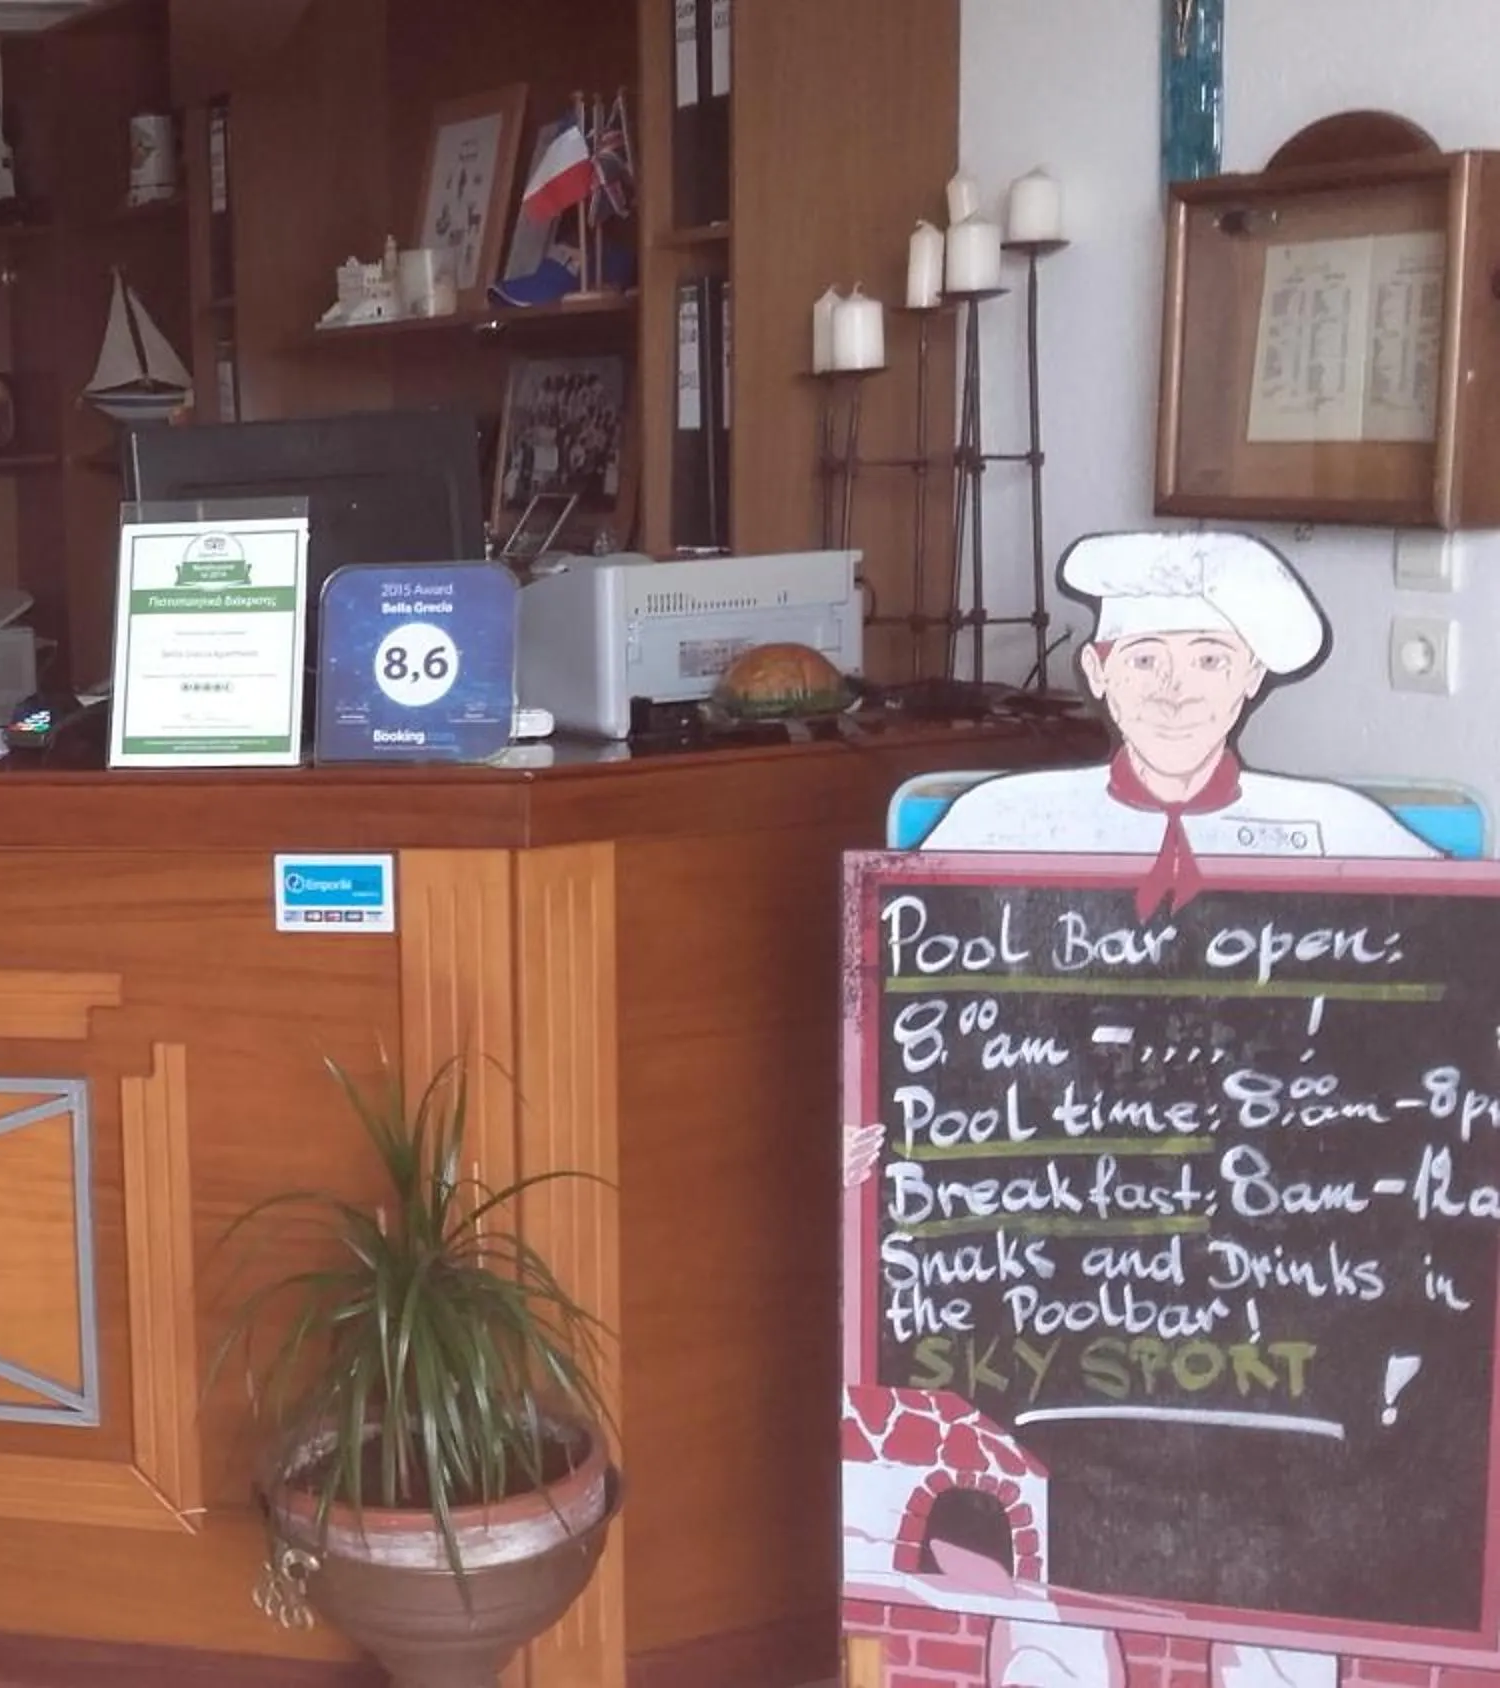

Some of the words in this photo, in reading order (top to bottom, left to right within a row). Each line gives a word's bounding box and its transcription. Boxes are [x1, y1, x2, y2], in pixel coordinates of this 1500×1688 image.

[381, 583, 412, 597] 2015
[414, 582, 454, 595] Award
[381, 602, 412, 615] Bella
[383, 645, 450, 685] 8,6
[882, 895, 1029, 976] Pool
[1052, 911, 1177, 970] Bar
[1206, 921, 1405, 984] open:
[893, 1082, 1037, 1158] Pool
[1053, 1080, 1222, 1137] time:
[885, 1152, 1218, 1223] Breakfast:
[881, 1230, 1056, 1291] Snaks
[1081, 1235, 1186, 1288] and
[1208, 1240, 1385, 1302] Drinks
[1424, 1256, 1472, 1313] in
[885, 1286, 975, 1342] the
[907, 1336, 1063, 1402] SKY
[1080, 1336, 1318, 1400] SPORT
